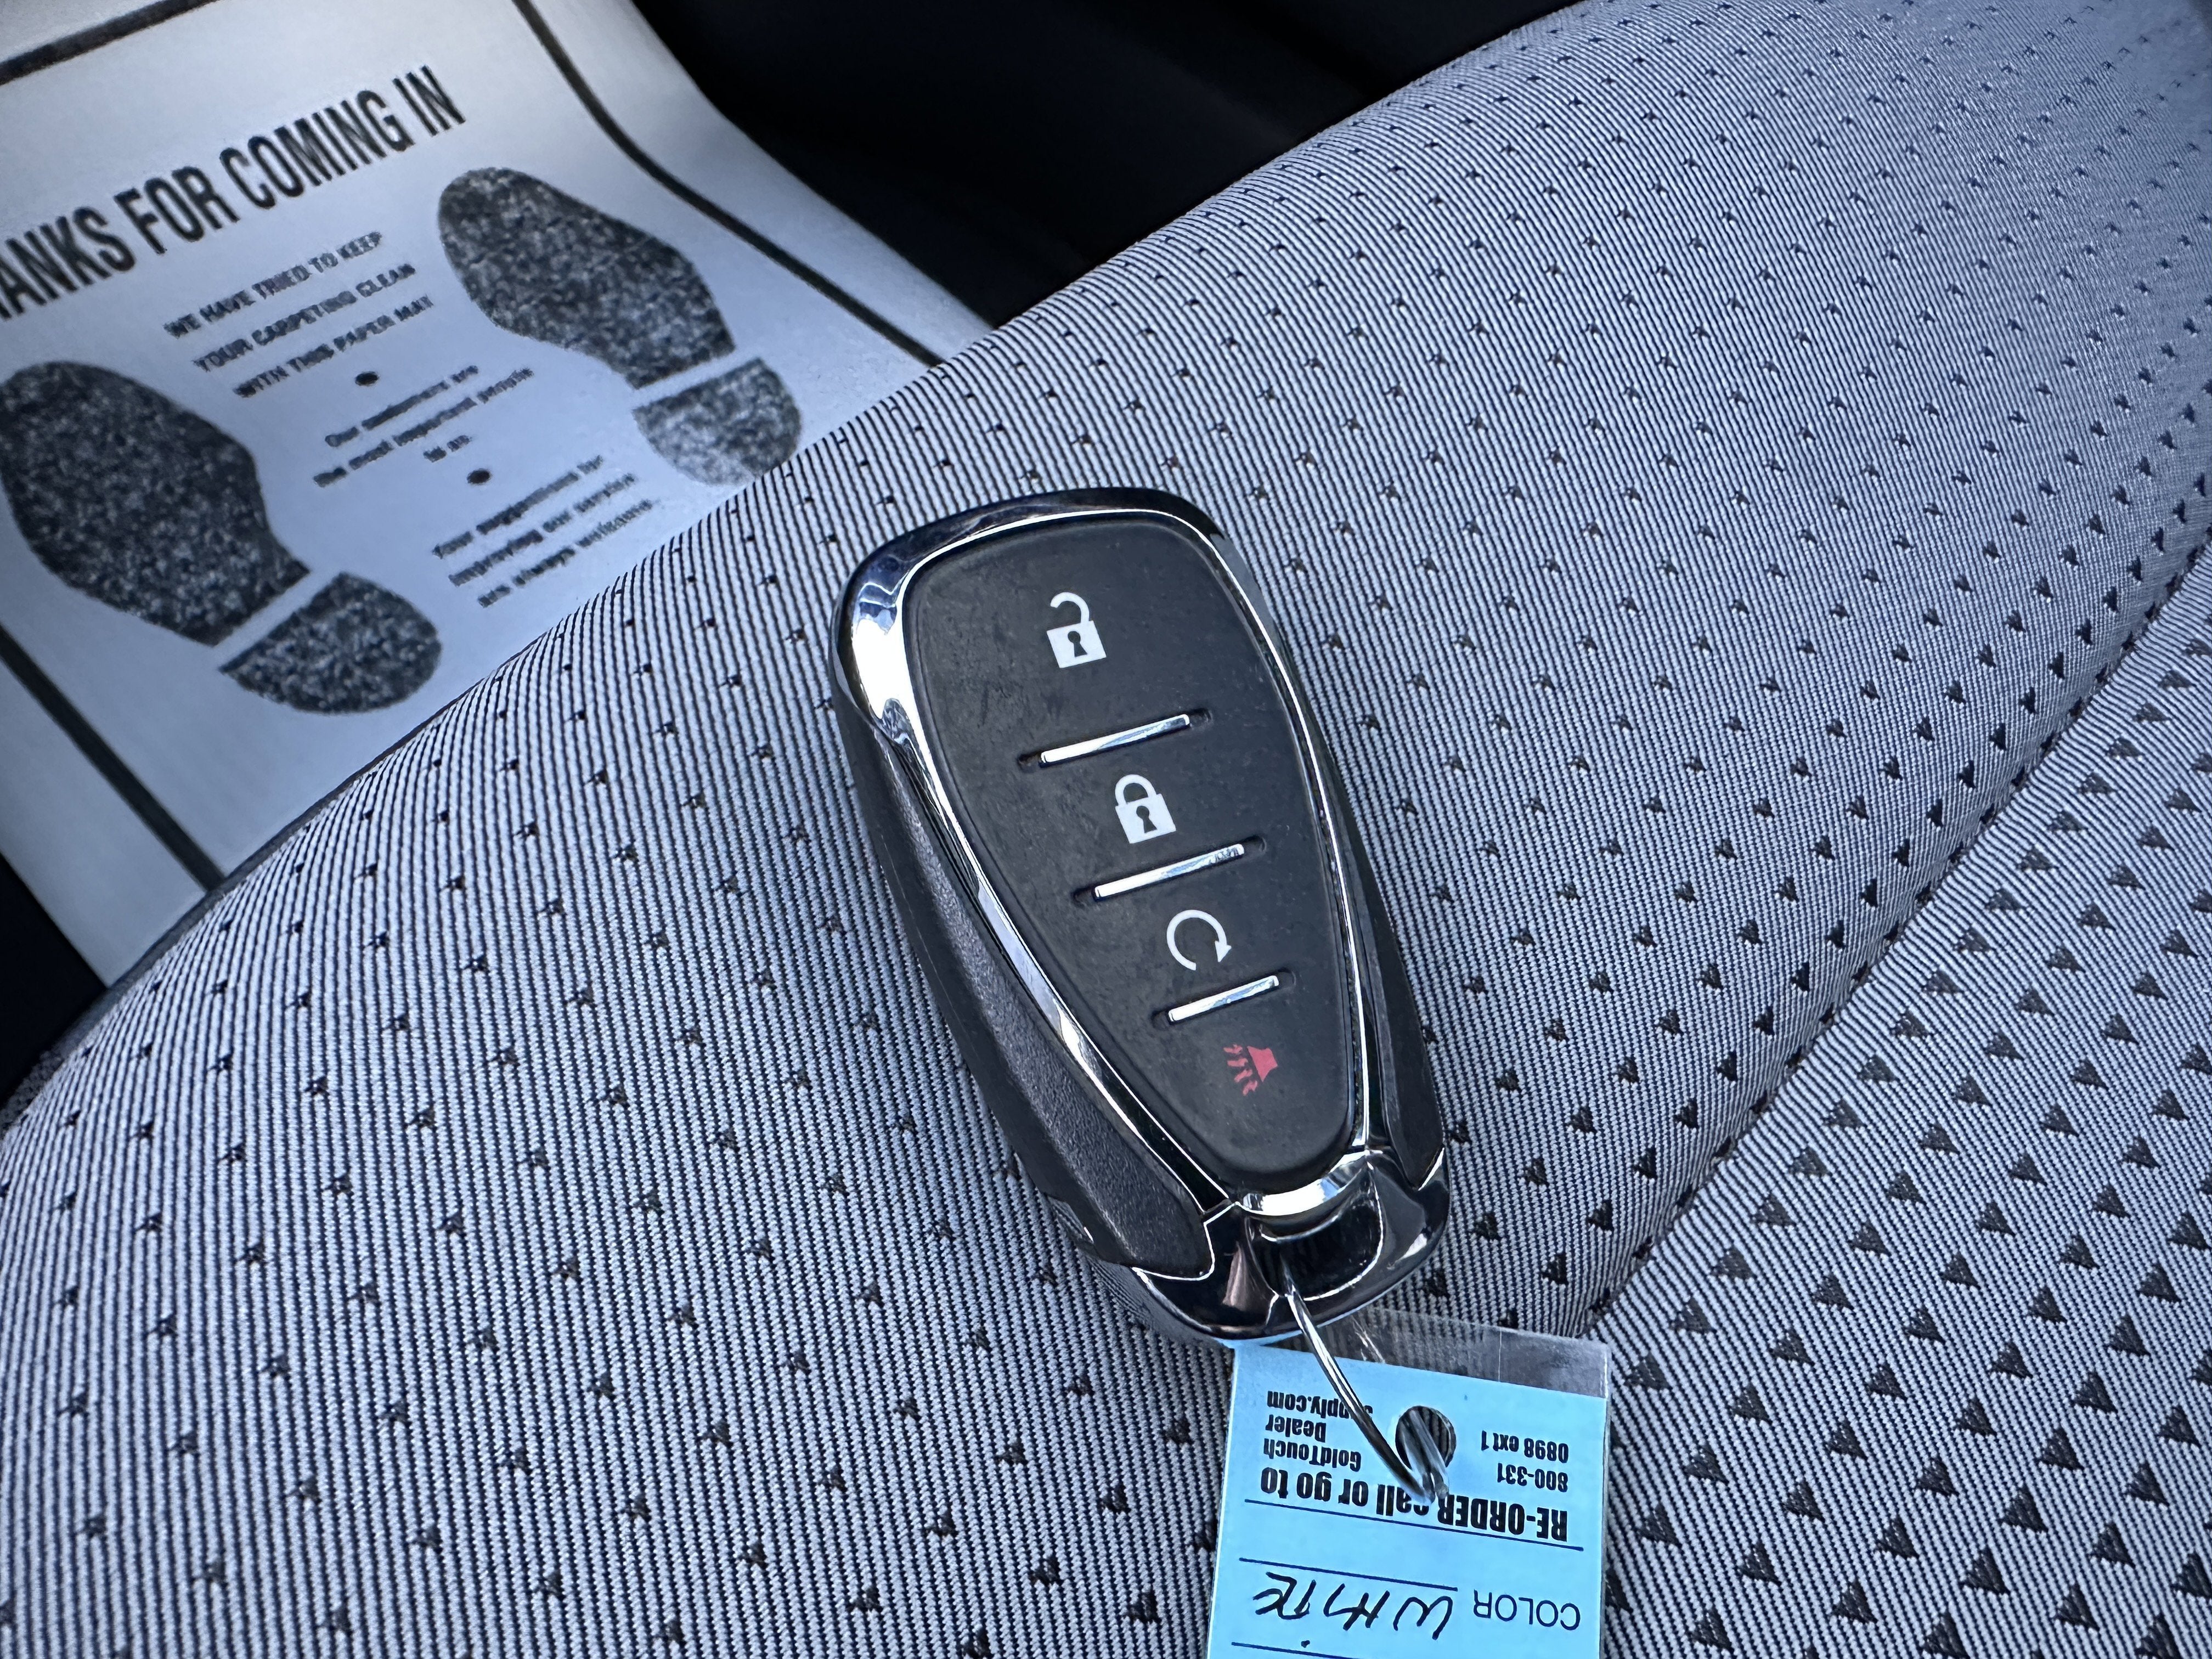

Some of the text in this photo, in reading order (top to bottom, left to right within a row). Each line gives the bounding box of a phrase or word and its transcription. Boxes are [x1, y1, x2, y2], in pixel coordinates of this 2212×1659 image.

[0, 65, 466, 319] ANKS FOR COMING IN
[1265, 1414, 1327, 1443] Dealer
[1263, 1438, 1362, 1472] GoldTouch
[1481, 1430, 1569, 1464] 0898 ext 1
[1261, 1467, 1289, 1499] to
[1296, 1471, 1333, 1502] go
[1339, 1478, 1369, 1506] or
[1497, 1462, 1568, 1493] 800-331
[1437, 1494, 1568, 1542] RE-ORDER
[1472, 1589, 1581, 1631] COLOR
